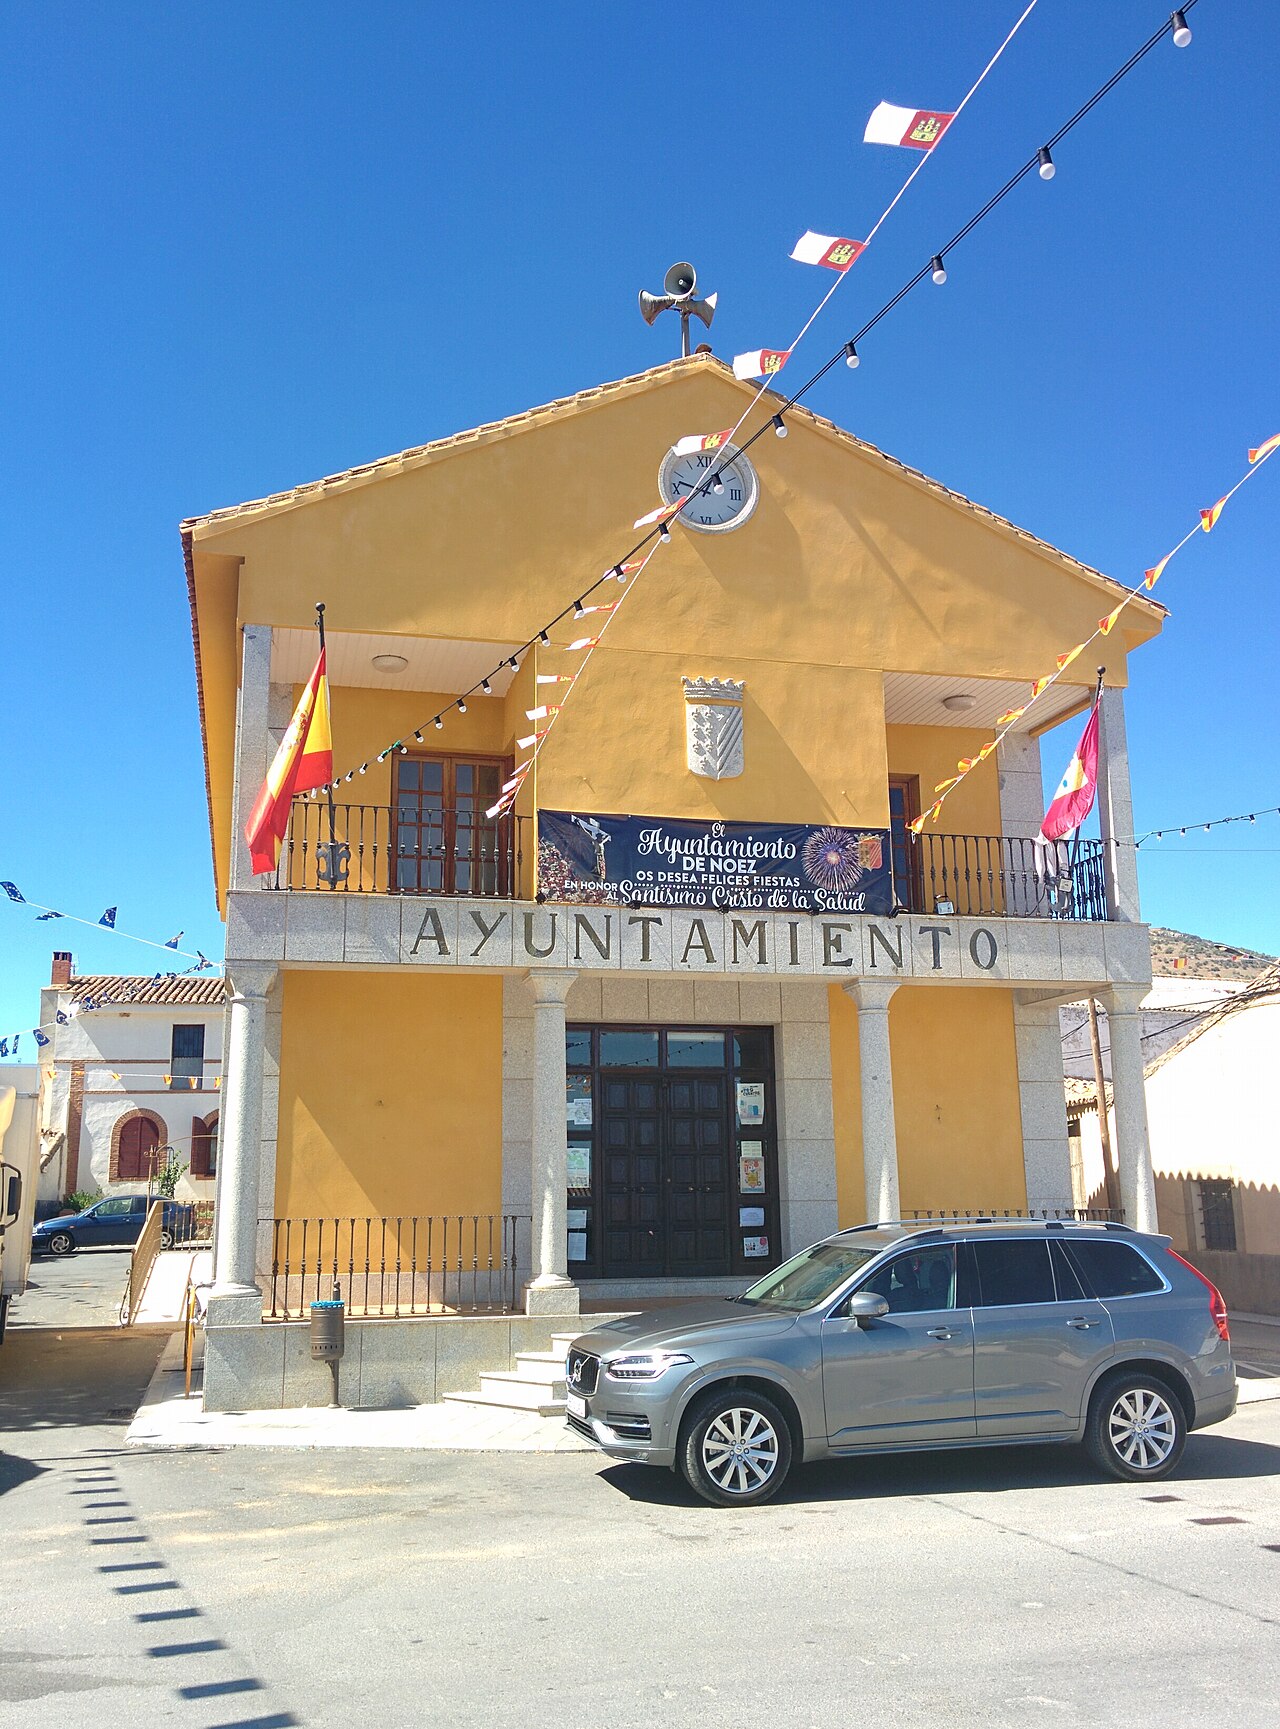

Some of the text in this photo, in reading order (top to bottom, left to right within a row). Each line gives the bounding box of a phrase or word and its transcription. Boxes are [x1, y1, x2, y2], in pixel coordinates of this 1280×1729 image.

[730, 488, 742, 501] III
[711, 821, 726, 838] El
[637, 827, 797, 864] Ayuntamiento
[682, 856, 757, 874] DE NOEZ
[564, 880, 619, 891] EN HONOR
[636, 870, 801, 888] OS DESEA FELICES FIESTAS
[605, 891, 619, 901] AL
[711, 885, 763, 909] Cristo
[767, 888, 790, 909] de
[792, 889, 812, 911] la
[814, 887, 866, 912] Salud
[409, 907, 999, 971] AYUNTAMIENTO
